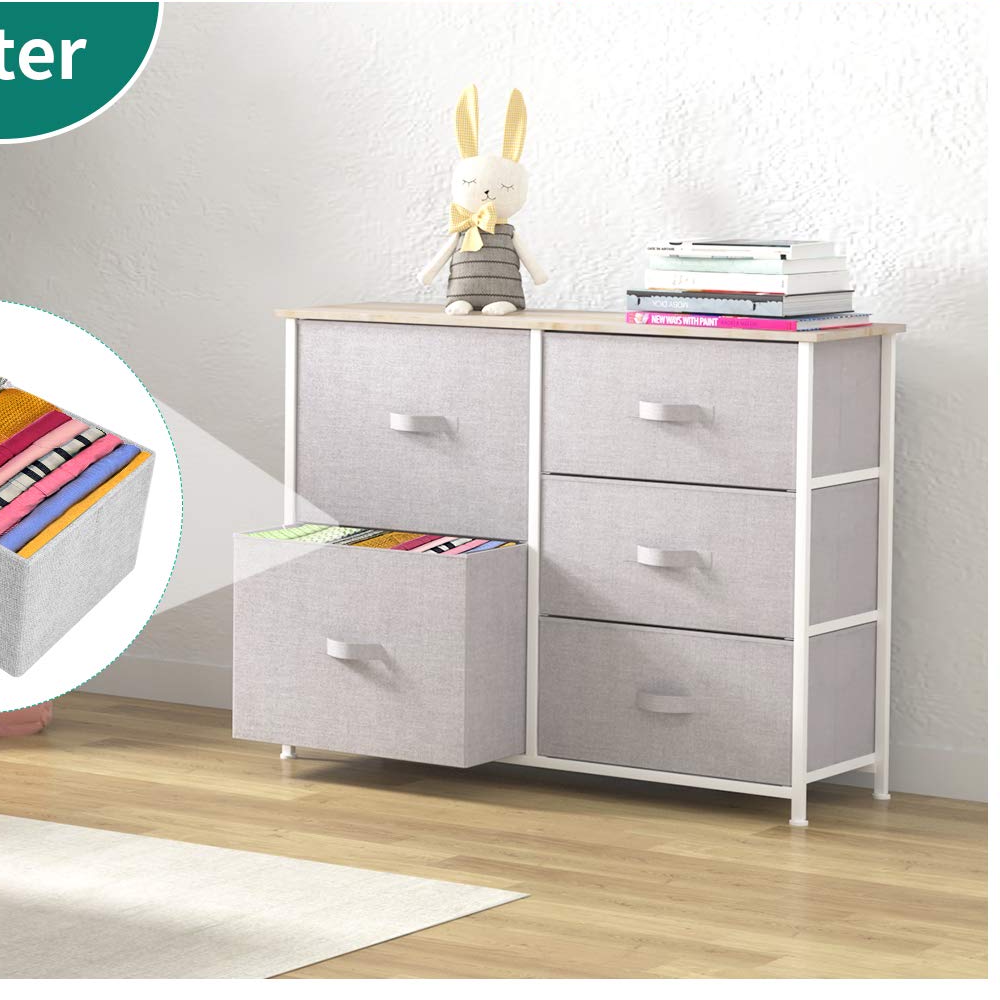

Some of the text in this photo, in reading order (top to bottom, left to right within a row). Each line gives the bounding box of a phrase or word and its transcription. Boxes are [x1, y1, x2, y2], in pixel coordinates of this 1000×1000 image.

[651, 315, 666, 324] NEW
[665, 316, 682, 325] WAYS
[683, 317, 699, 326] WITH
[699, 318, 718, 327] PAINT
